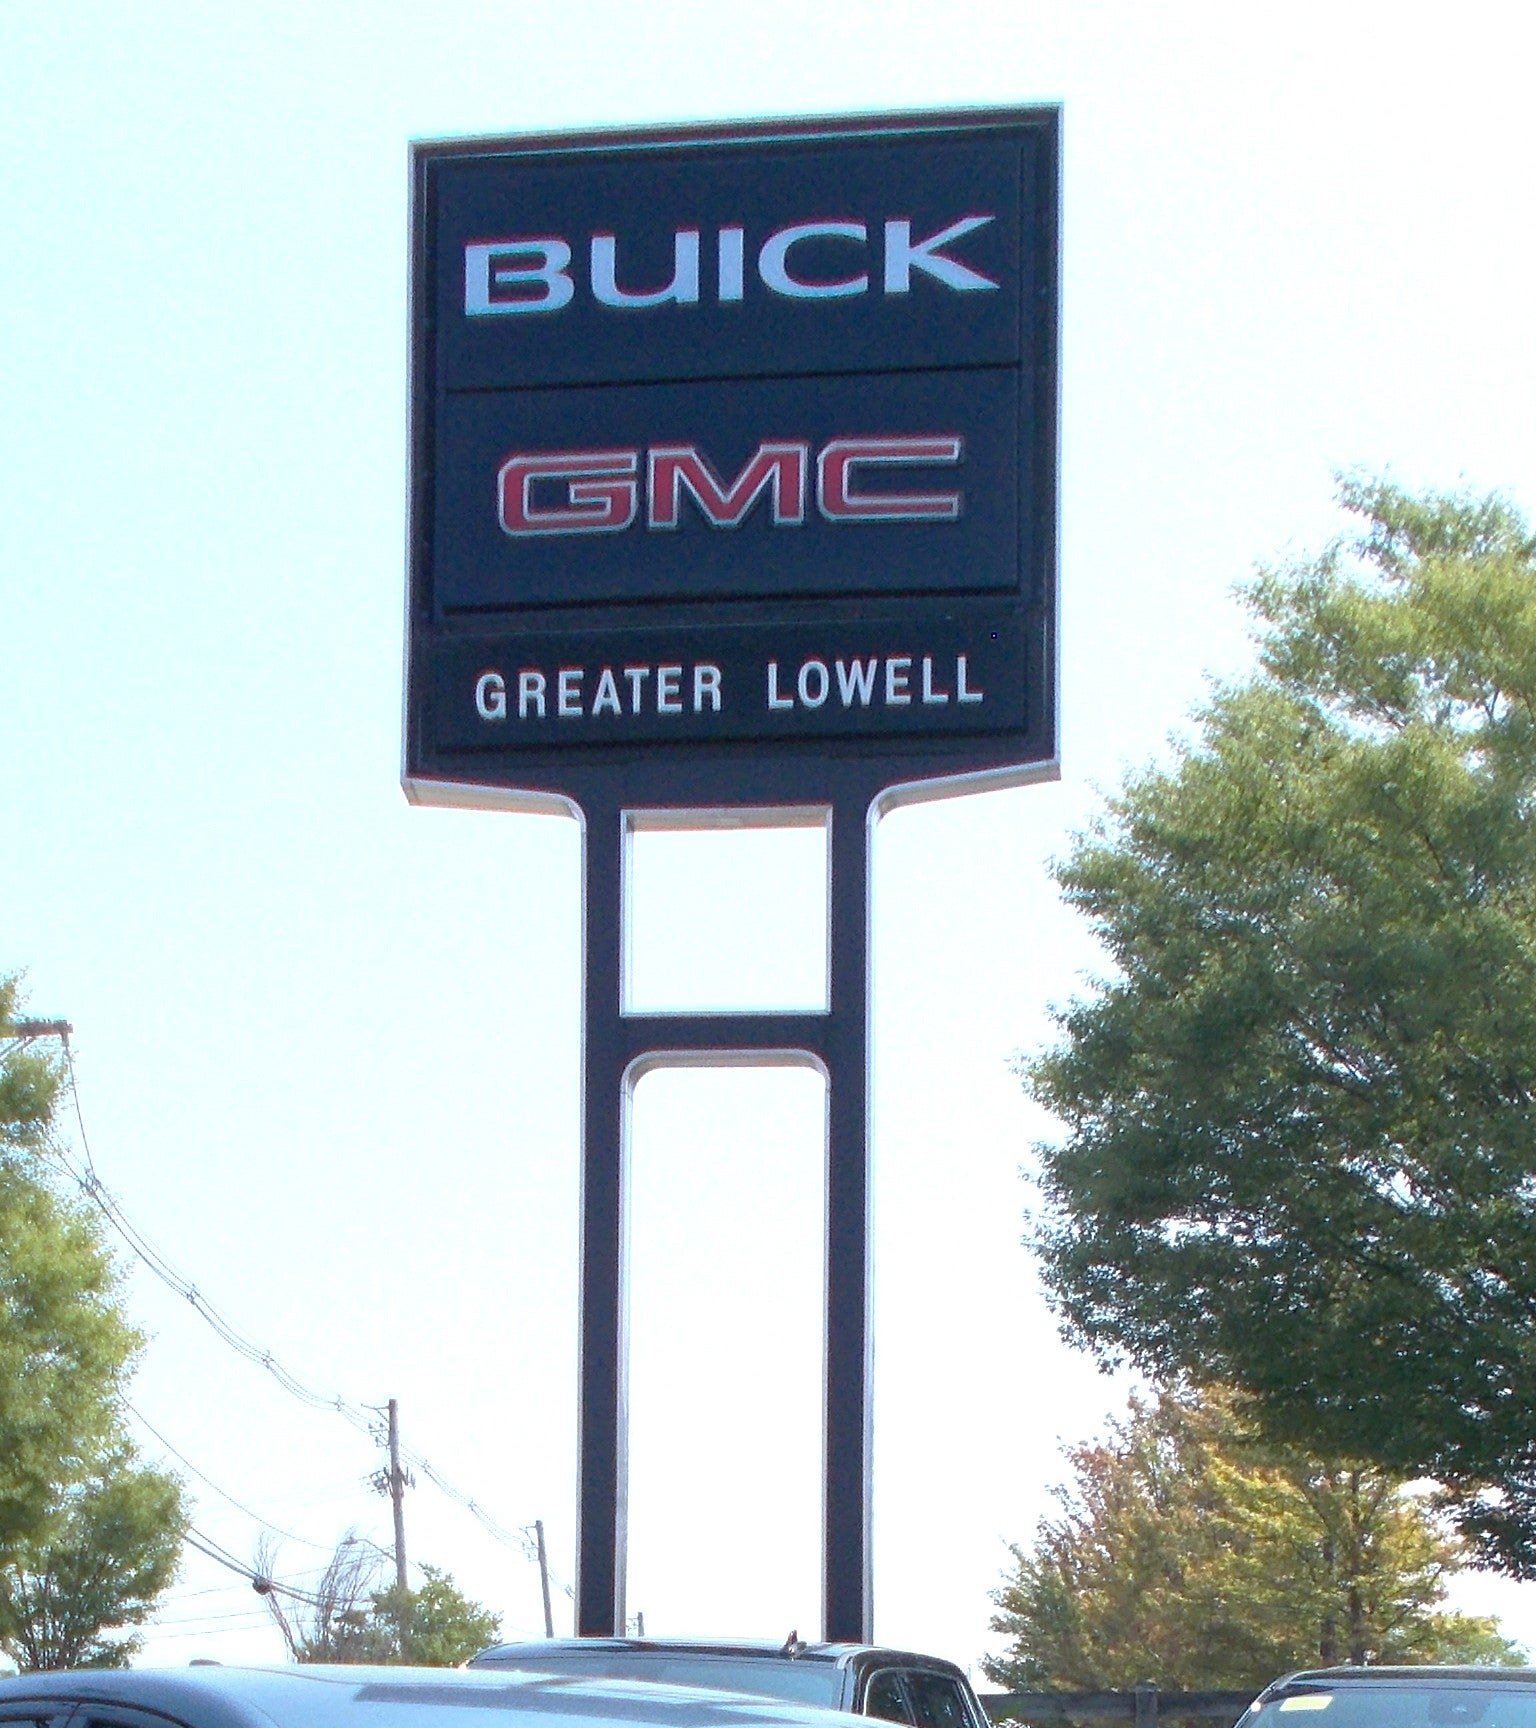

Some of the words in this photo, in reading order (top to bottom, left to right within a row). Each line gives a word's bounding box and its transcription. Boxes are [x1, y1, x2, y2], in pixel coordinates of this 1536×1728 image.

[465, 216, 1000, 317] BUICK
[498, 436, 961, 537] GMC
[474, 664, 722, 719] GREATER
[767, 656, 983, 711] LOWELL
